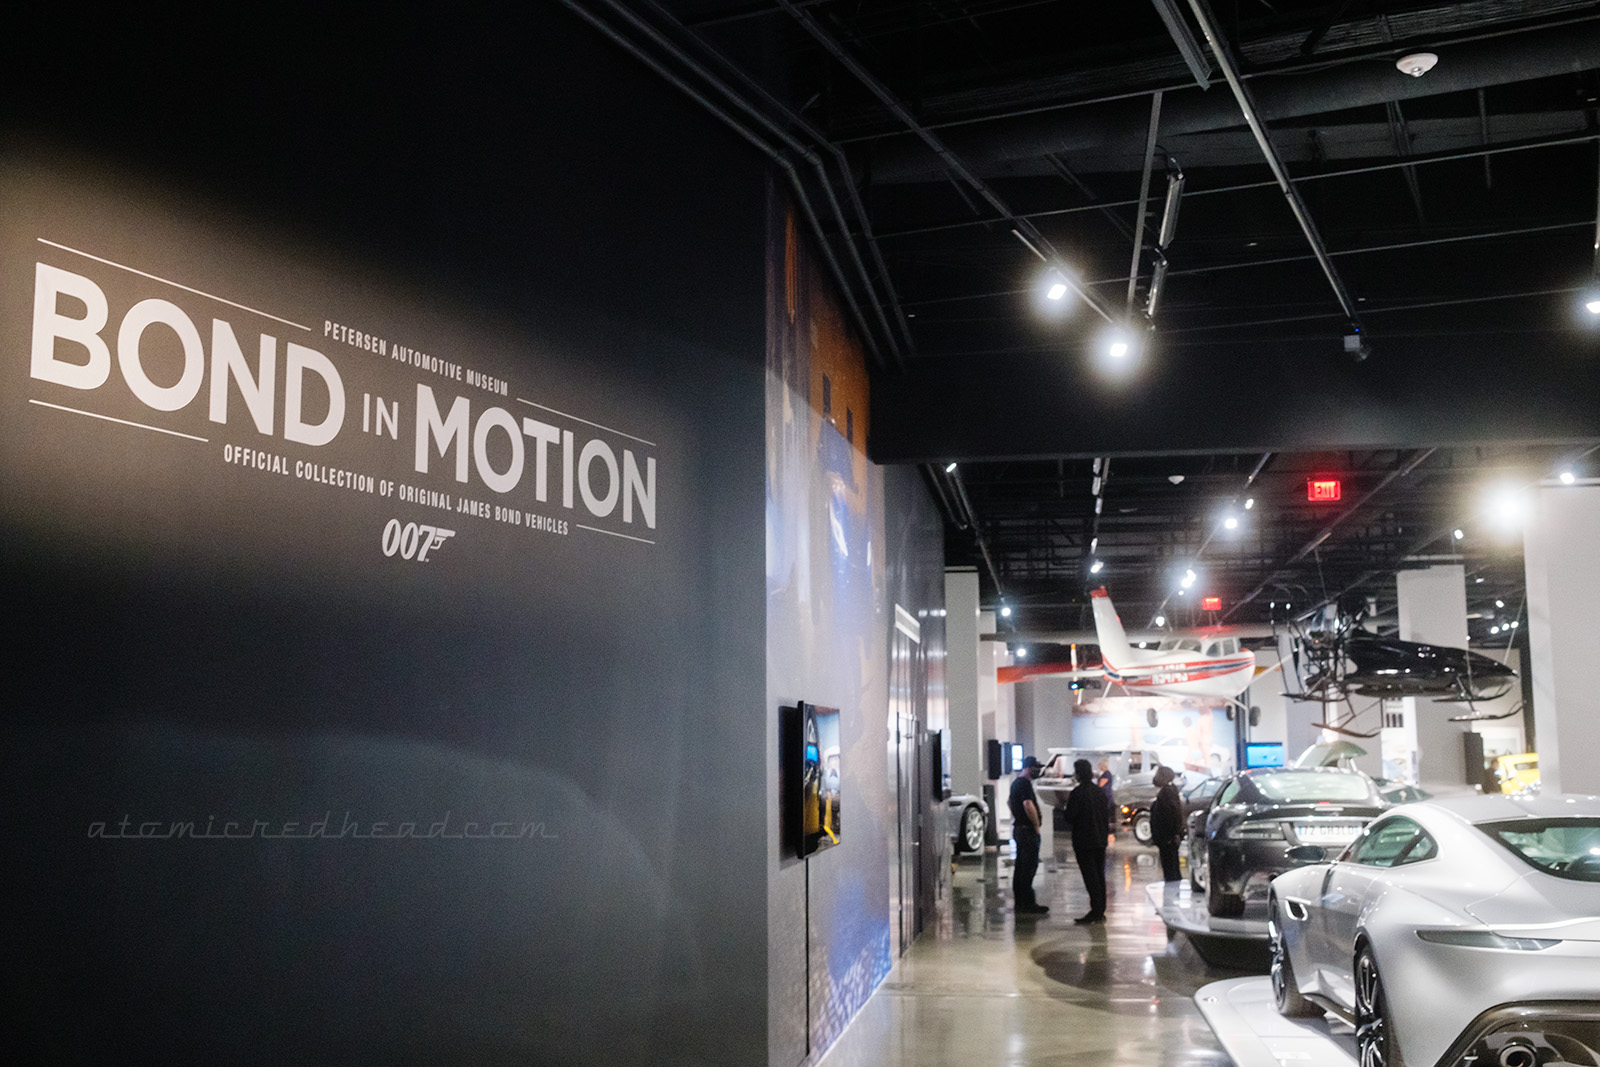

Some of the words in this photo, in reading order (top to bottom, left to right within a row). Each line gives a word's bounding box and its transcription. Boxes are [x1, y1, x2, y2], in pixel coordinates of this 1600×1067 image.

[29, 261, 346, 447] BOND
[363, 392, 399, 441] IN
[414, 384, 656, 530] MOTION
[324, 320, 388, 356] PETERSEN
[391, 343, 463, 381] AUTOMOTIVE
[466, 368, 509, 397] MUSEUM
[223, 443, 289, 476] OFFICIAL
[295, 460, 375, 494] COLLECTION
[379, 479, 395, 499] OF
[399, 483, 453, 511] ORIGINAL
[456, 497, 491, 520] JAMES
[494, 505, 522, 525] BOND
[525, 512, 569, 536] VEHICLES
[1313, 481, 1336, 498] EXIT
[381, 518, 449, 562] 007
